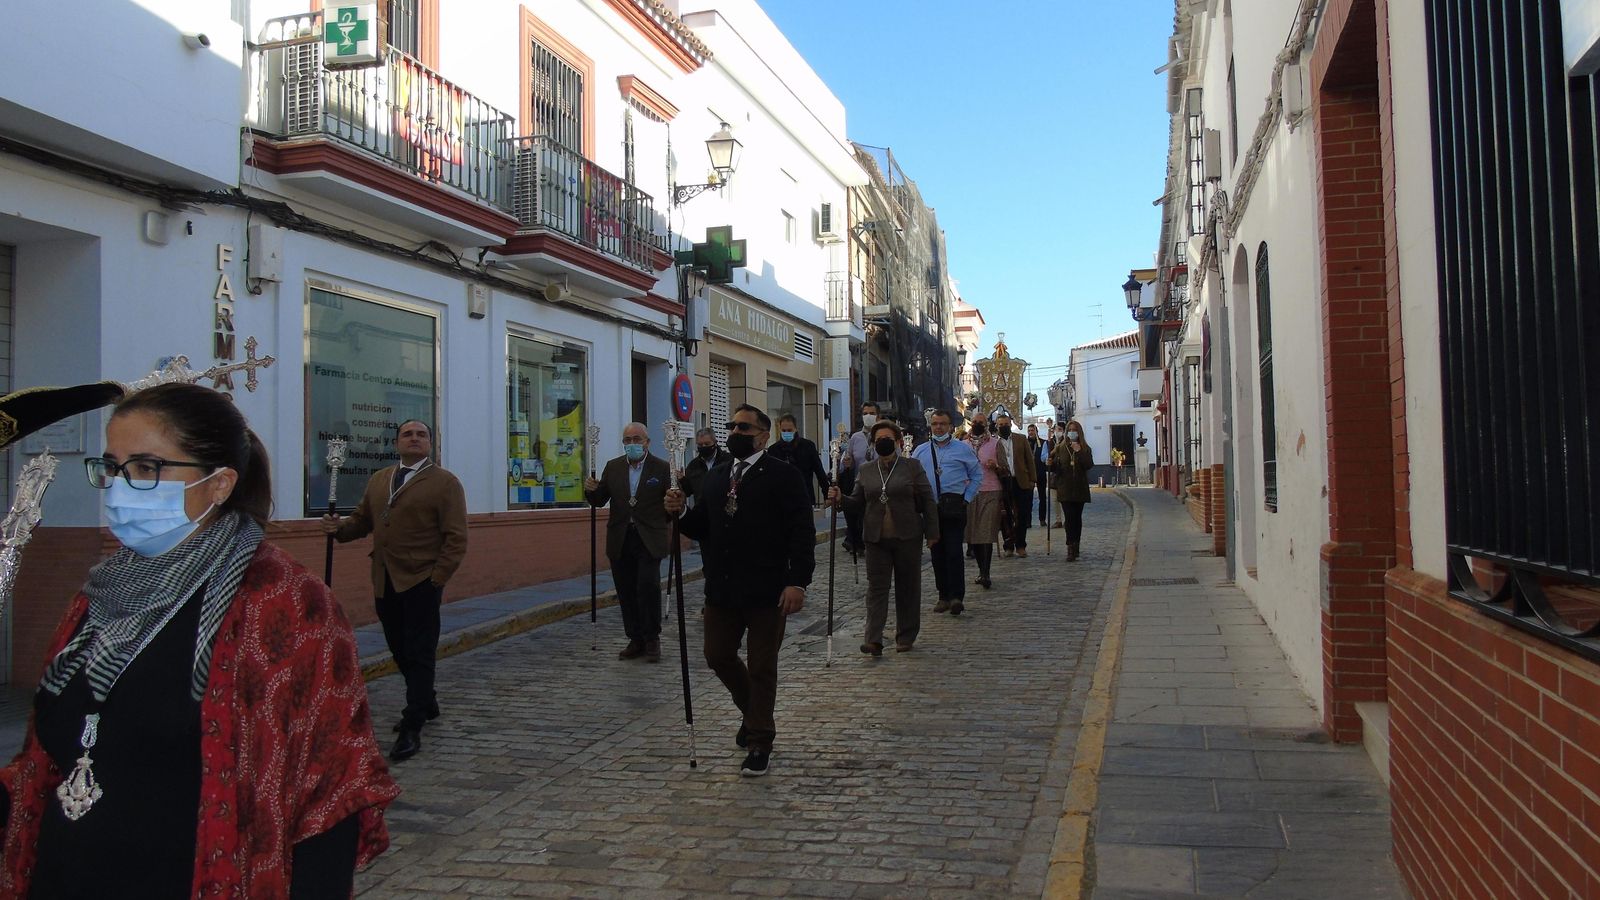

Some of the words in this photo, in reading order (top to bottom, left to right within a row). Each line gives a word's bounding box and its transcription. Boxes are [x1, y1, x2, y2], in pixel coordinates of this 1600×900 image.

[718, 298, 742, 326] ANA
[747, 309, 789, 344] HIDALGO
[314, 365, 361, 381] Farmacia
[362, 372, 393, 385] Centro
[357, 433, 382, 444] bucal
[384, 437, 390, 446] y
